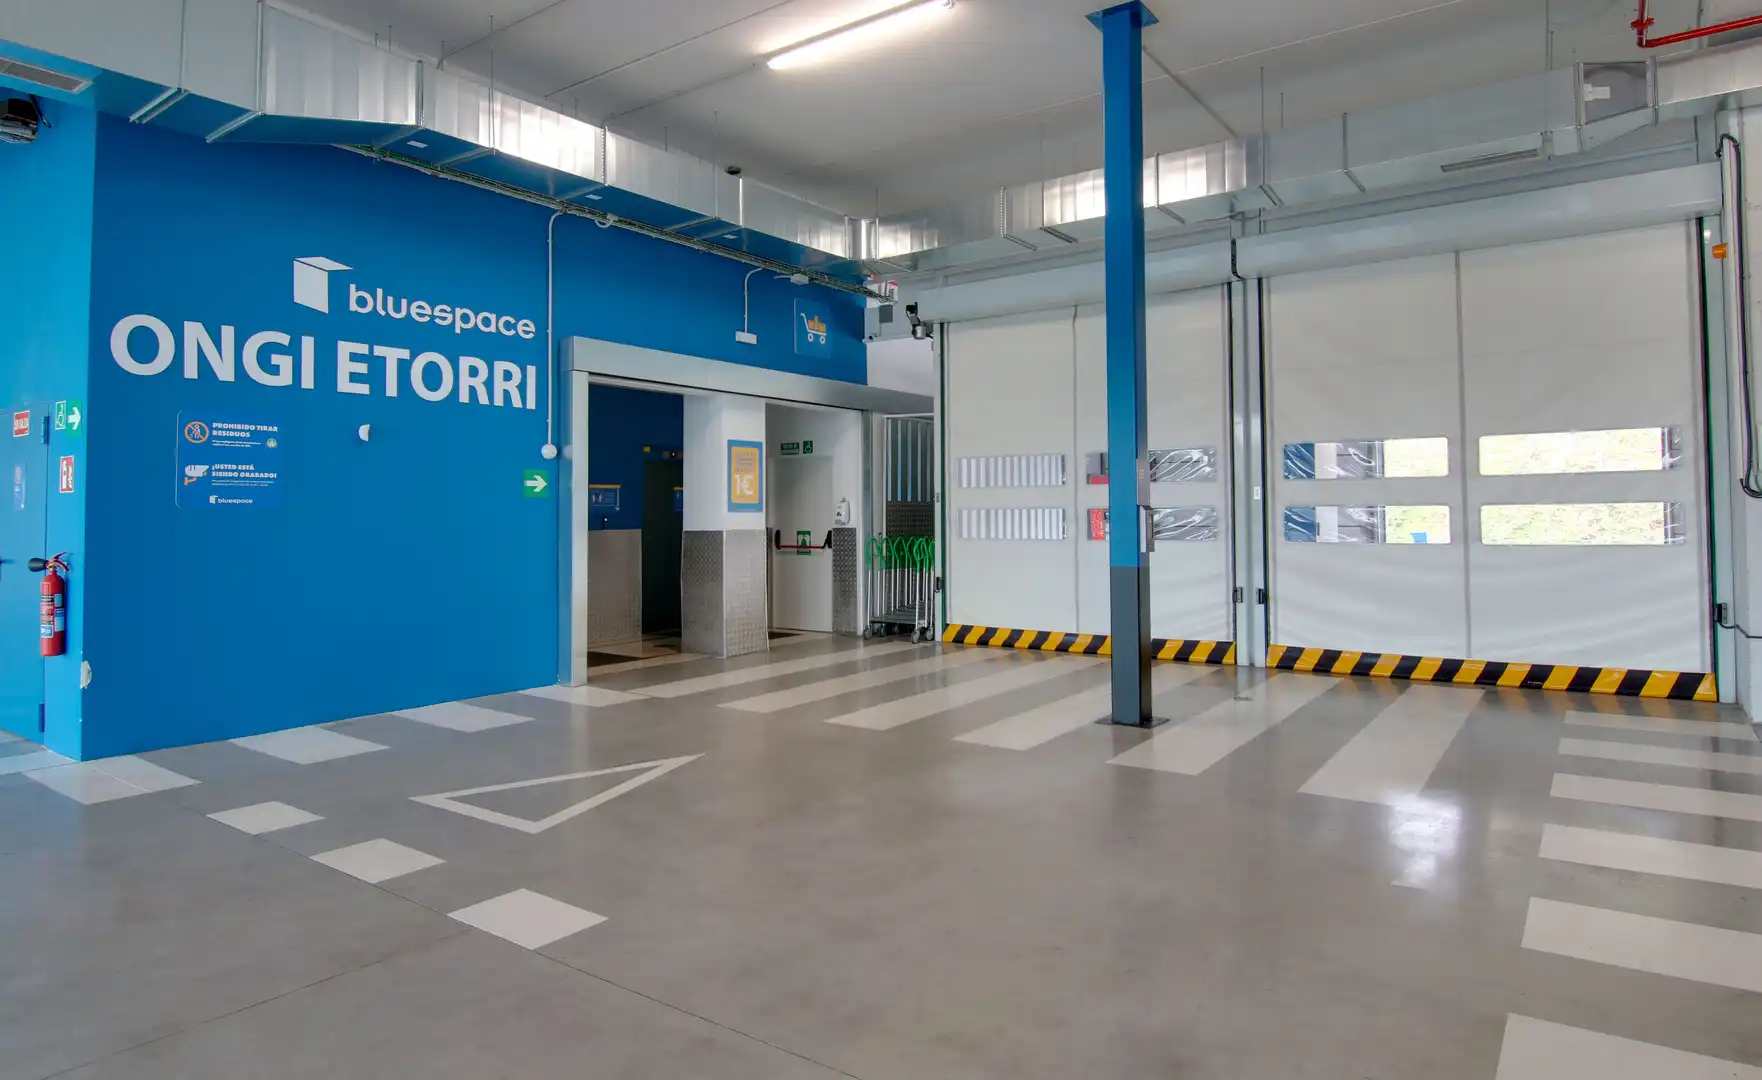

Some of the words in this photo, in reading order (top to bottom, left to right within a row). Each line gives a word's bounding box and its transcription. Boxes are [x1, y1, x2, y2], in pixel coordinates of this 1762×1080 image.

[348, 284, 536, 339] bluespace
[110, 314, 315, 390] ONGI
[337, 340, 537, 410] ETORRI
[212, 422, 255, 430] PROHIBIDO
